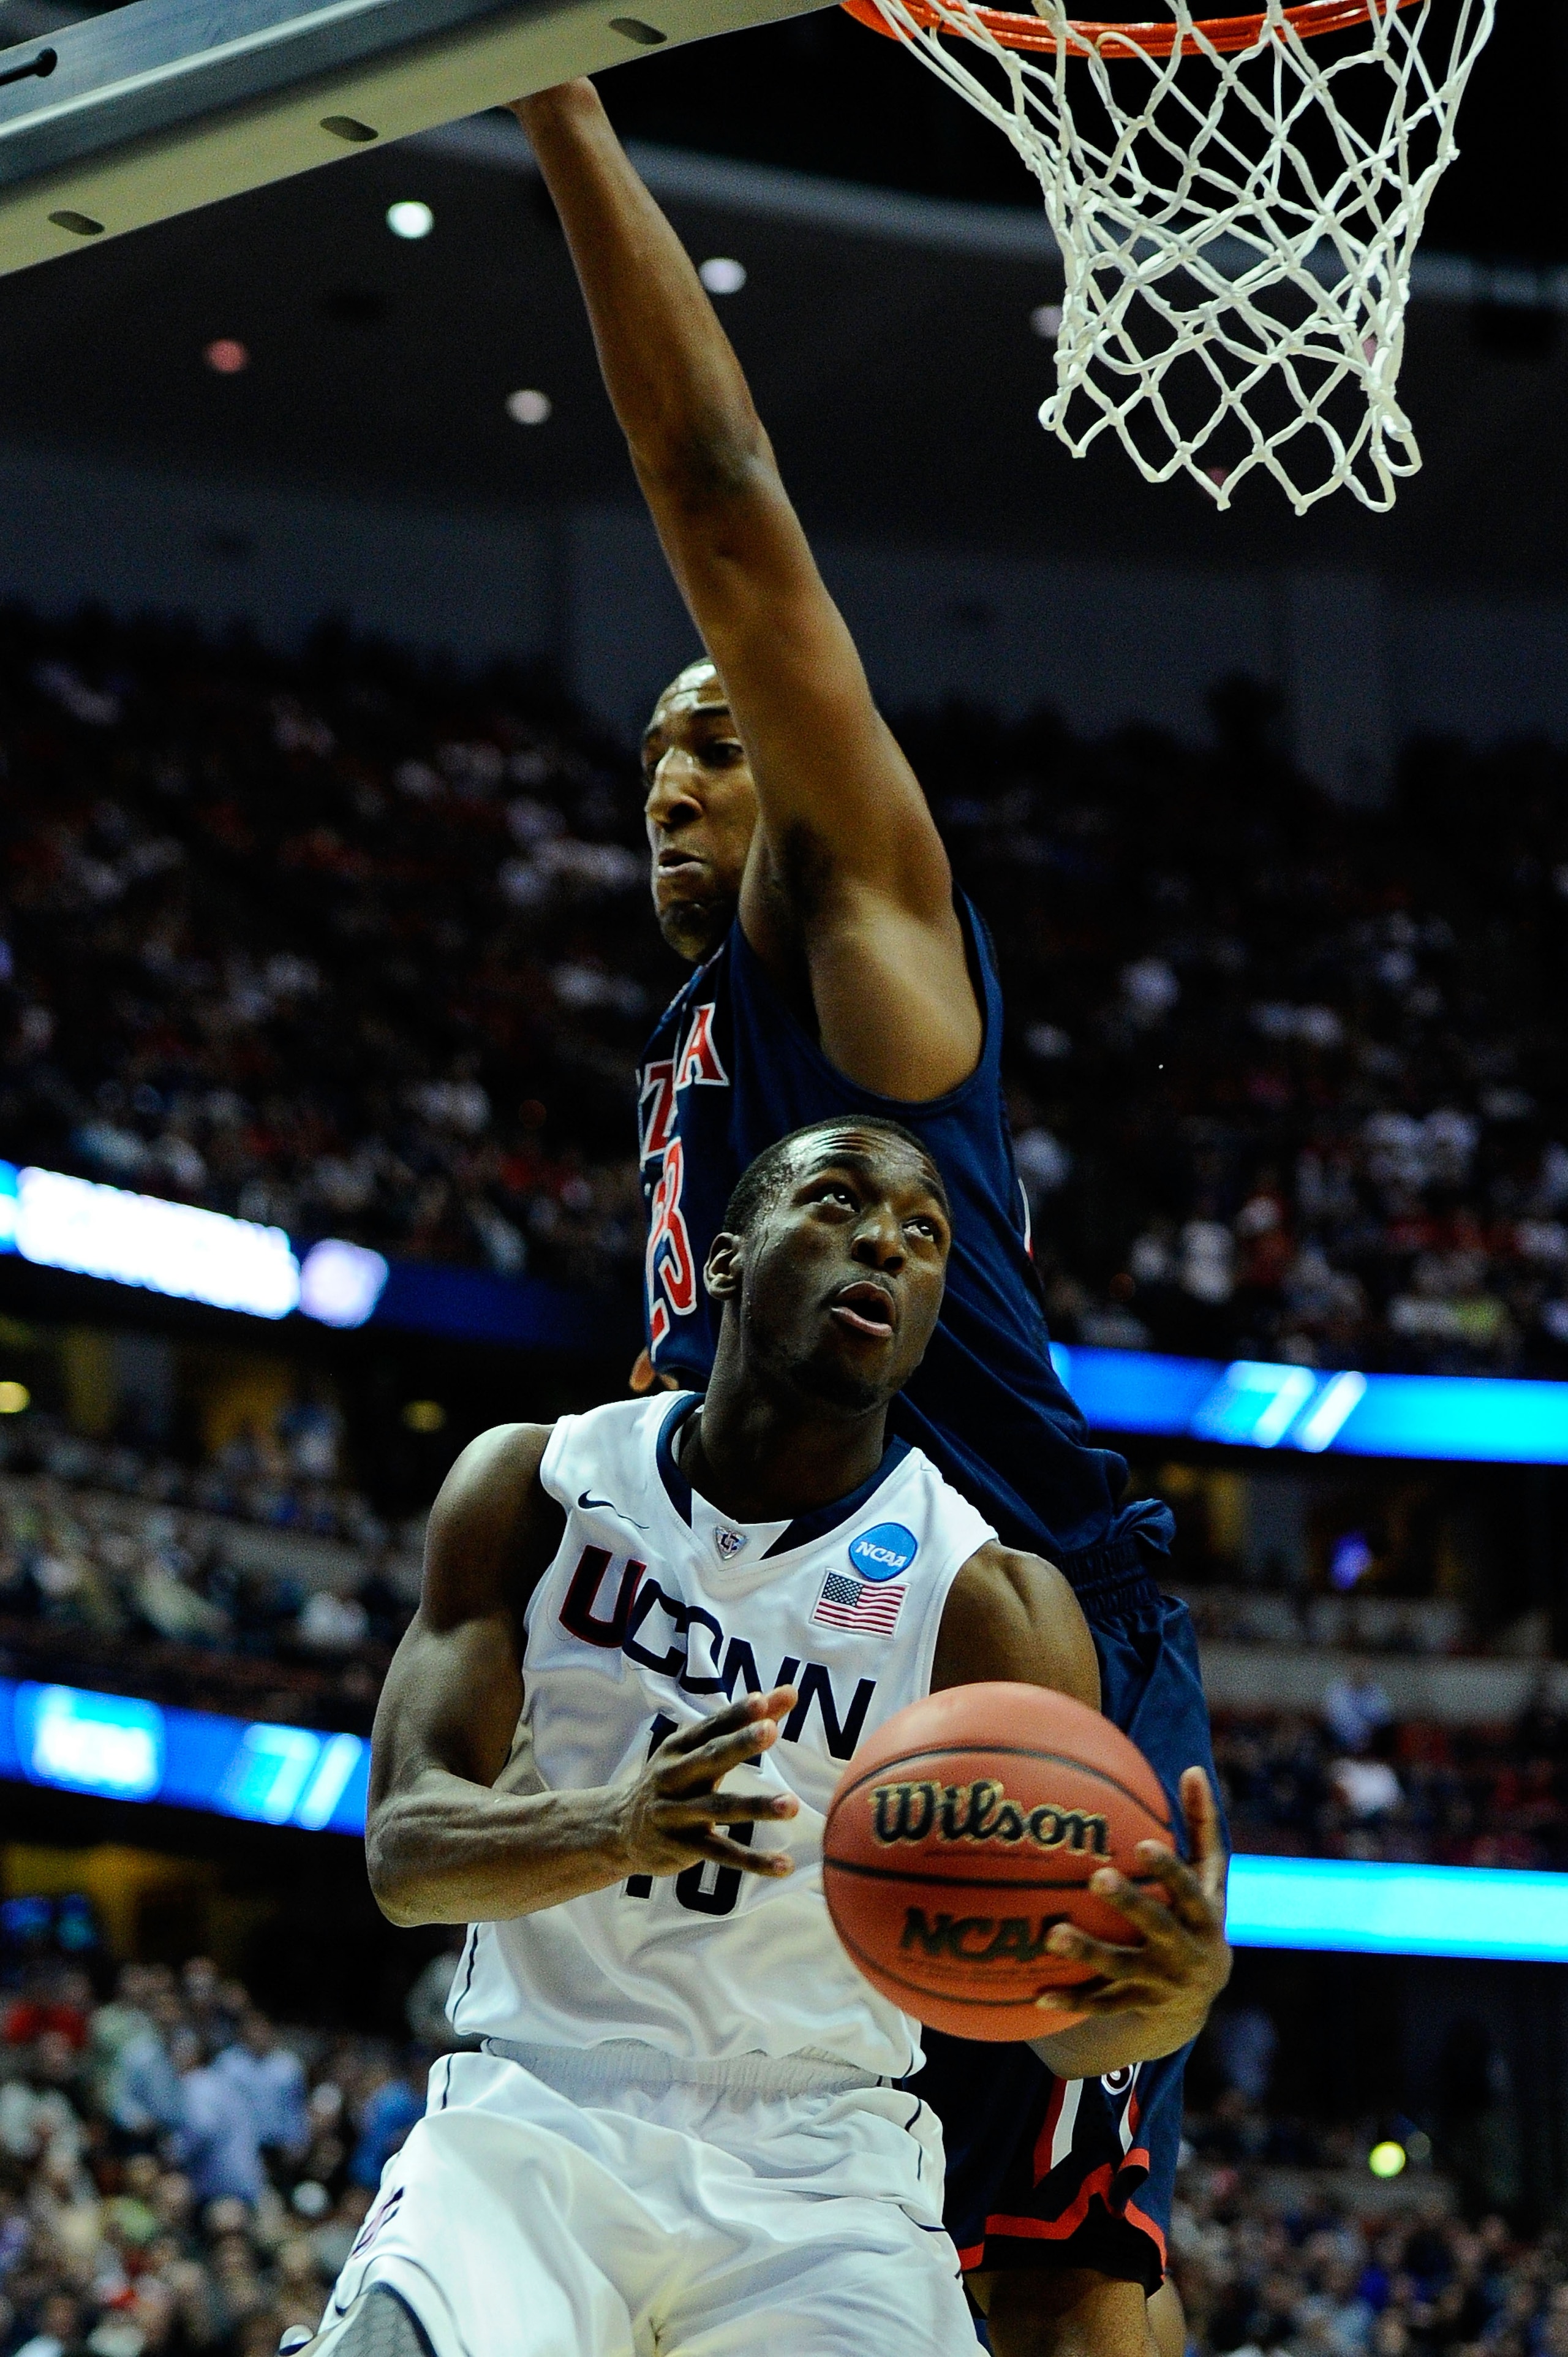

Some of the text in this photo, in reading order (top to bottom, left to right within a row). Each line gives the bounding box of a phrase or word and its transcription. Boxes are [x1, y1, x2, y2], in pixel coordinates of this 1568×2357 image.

[855, 1541, 908, 1568] NCAA
[558, 1544, 877, 1761] UCONN
[870, 1779, 1112, 1859] Wilson
